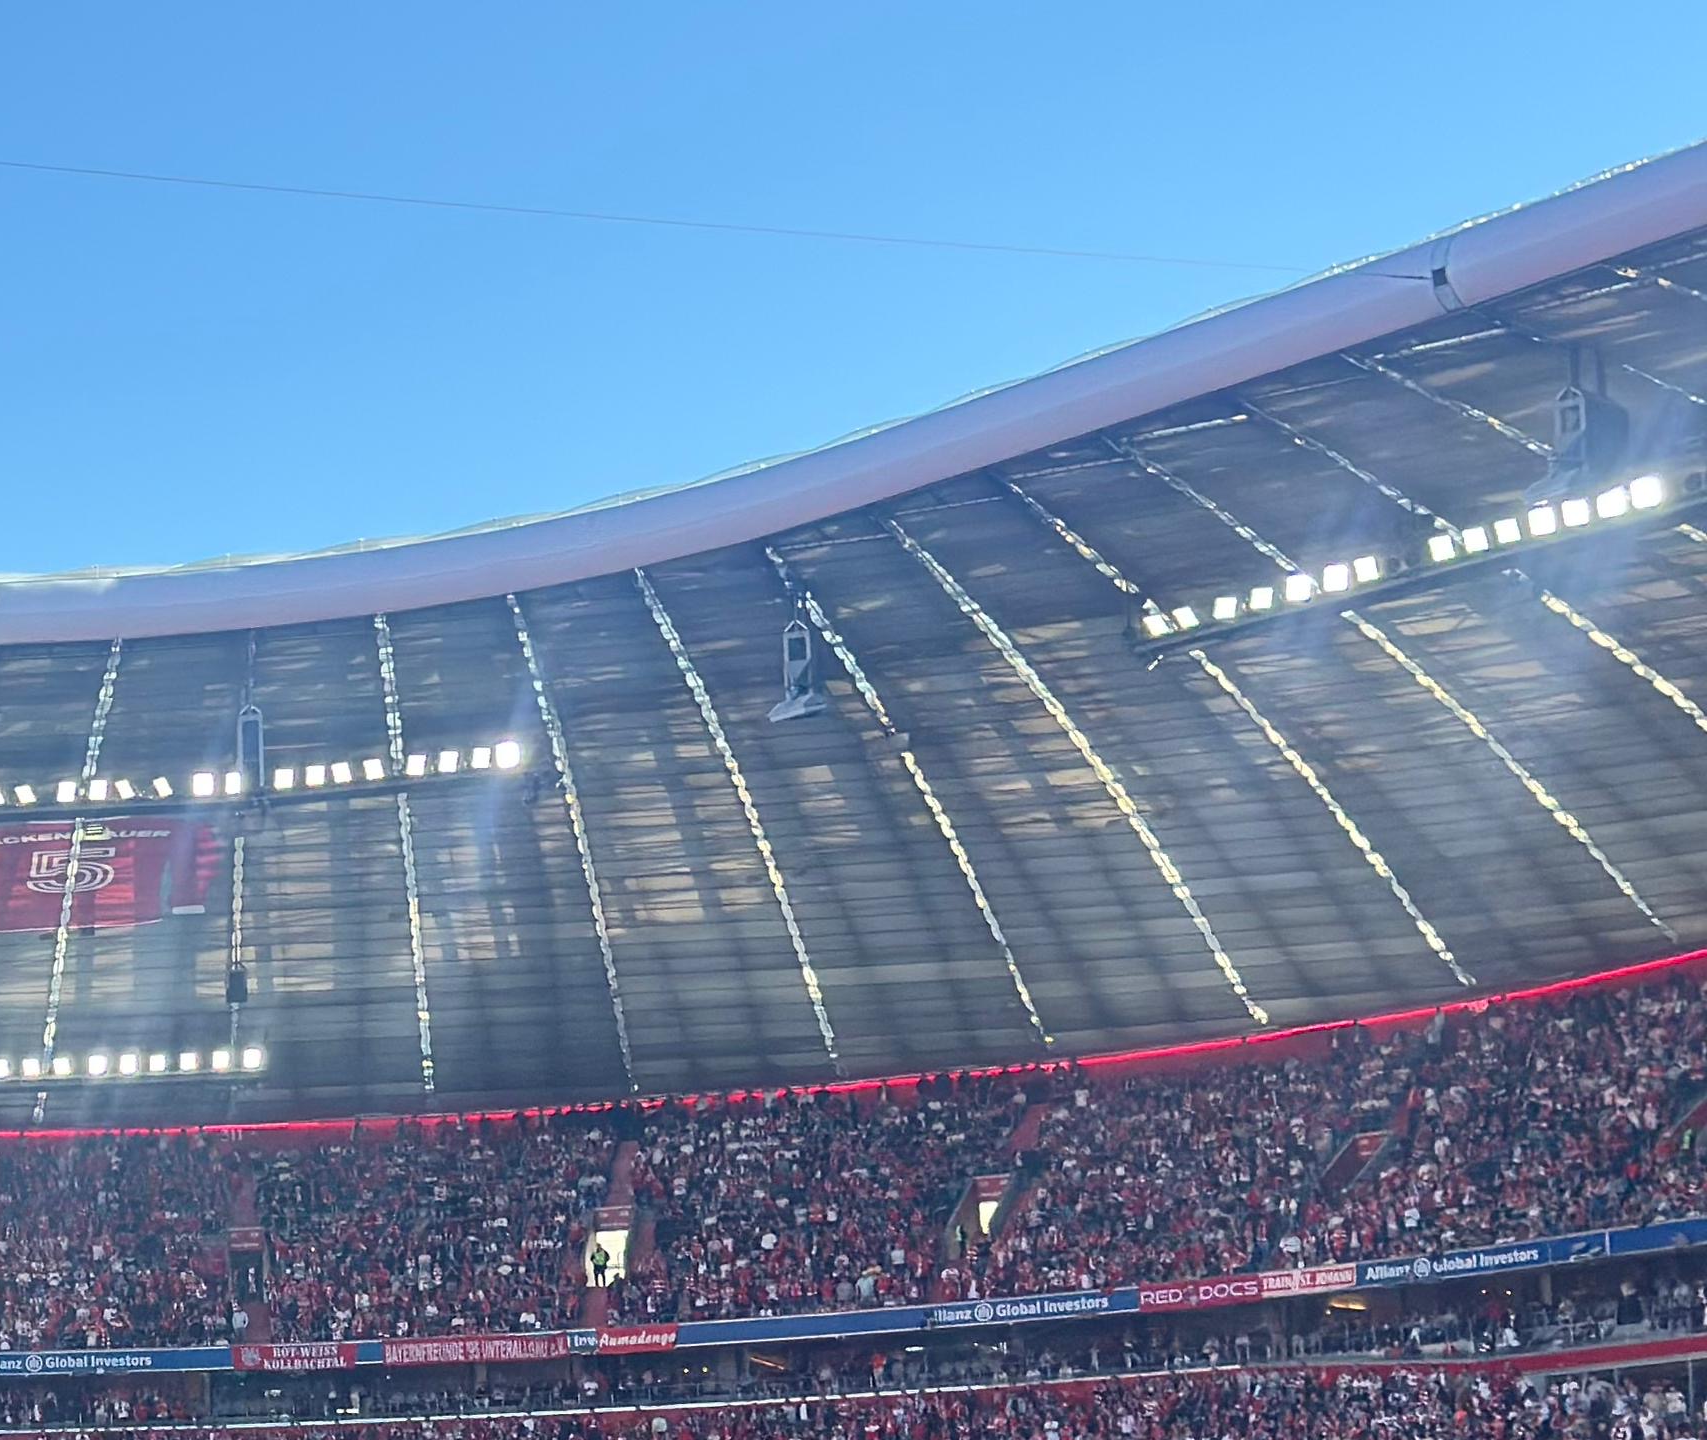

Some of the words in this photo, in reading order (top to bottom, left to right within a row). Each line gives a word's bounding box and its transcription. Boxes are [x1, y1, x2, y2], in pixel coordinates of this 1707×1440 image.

[26, 846, 115, 894] 5
[1480, 1248, 1539, 1267] Investors
[1140, 1289, 1182, 1306] RED
[1199, 1281, 1258, 1301] DOCS
[933, 1309, 972, 1321] llianz
[995, 1300, 1041, 1317] Global
[1043, 1295, 1109, 1313] Investors
[45, 1355, 88, 1370] Global
[90, 1354, 152, 1370] Investors
